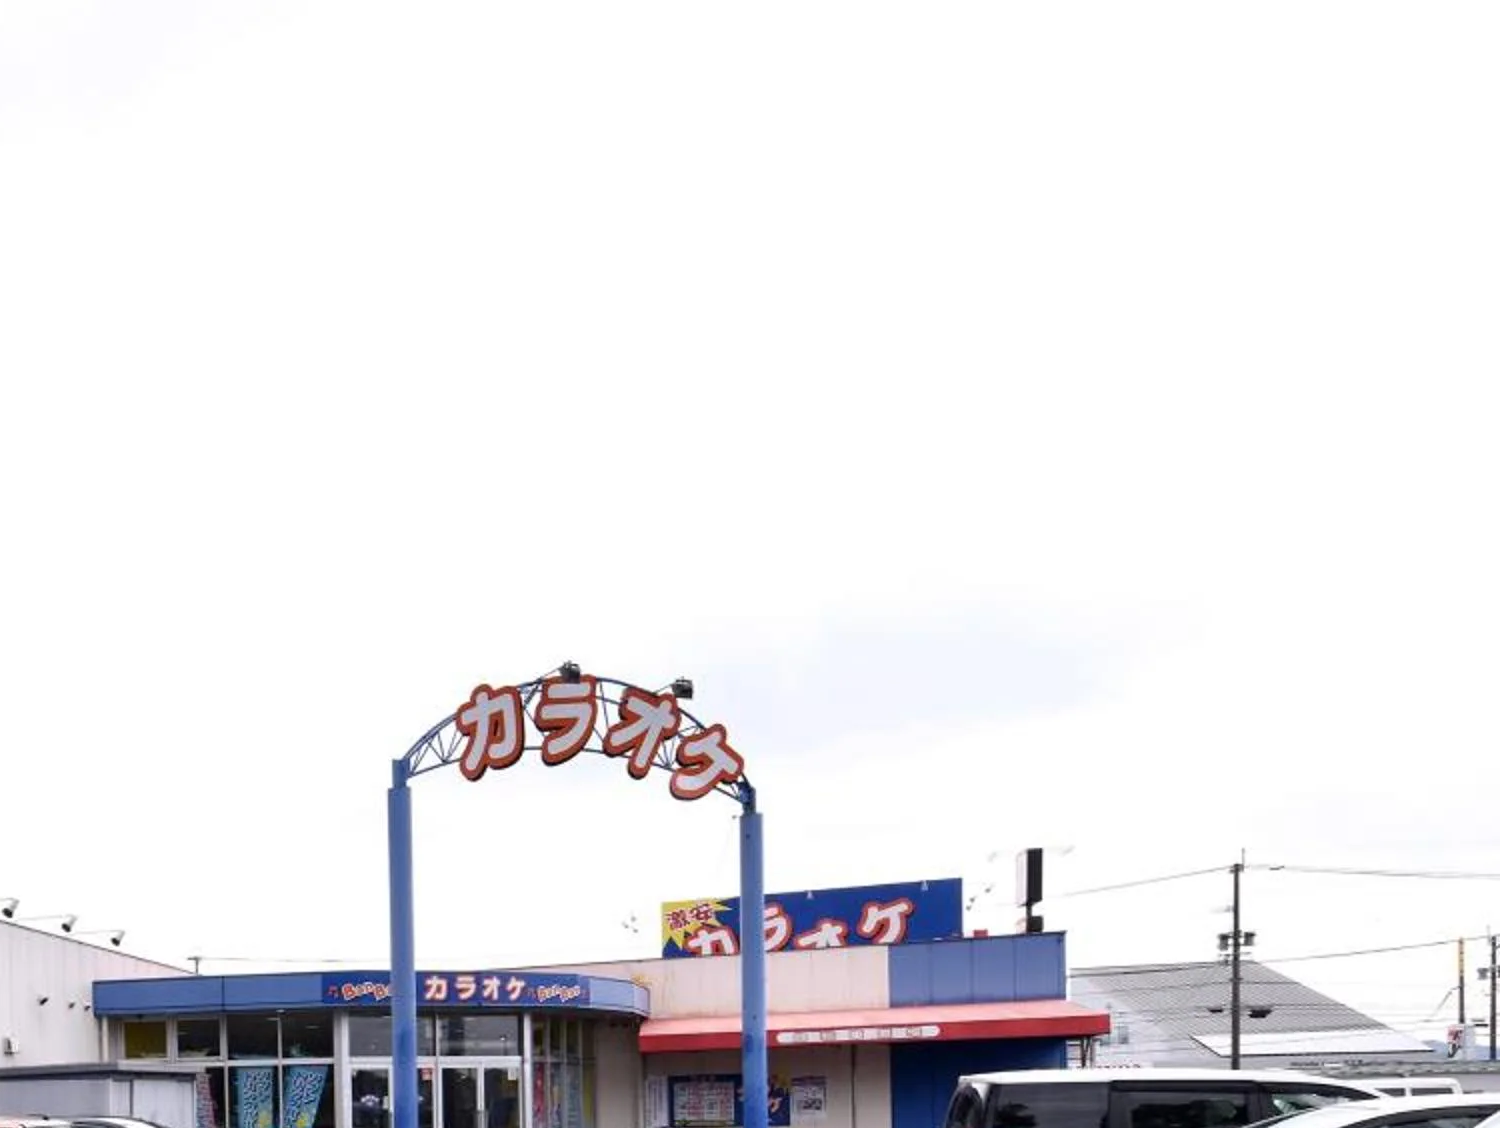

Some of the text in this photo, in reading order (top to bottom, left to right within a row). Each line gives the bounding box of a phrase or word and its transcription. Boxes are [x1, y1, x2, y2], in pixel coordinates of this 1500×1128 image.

[456, 674, 743, 801] カラオケ
[424, 975, 525, 1001] カラオケ
